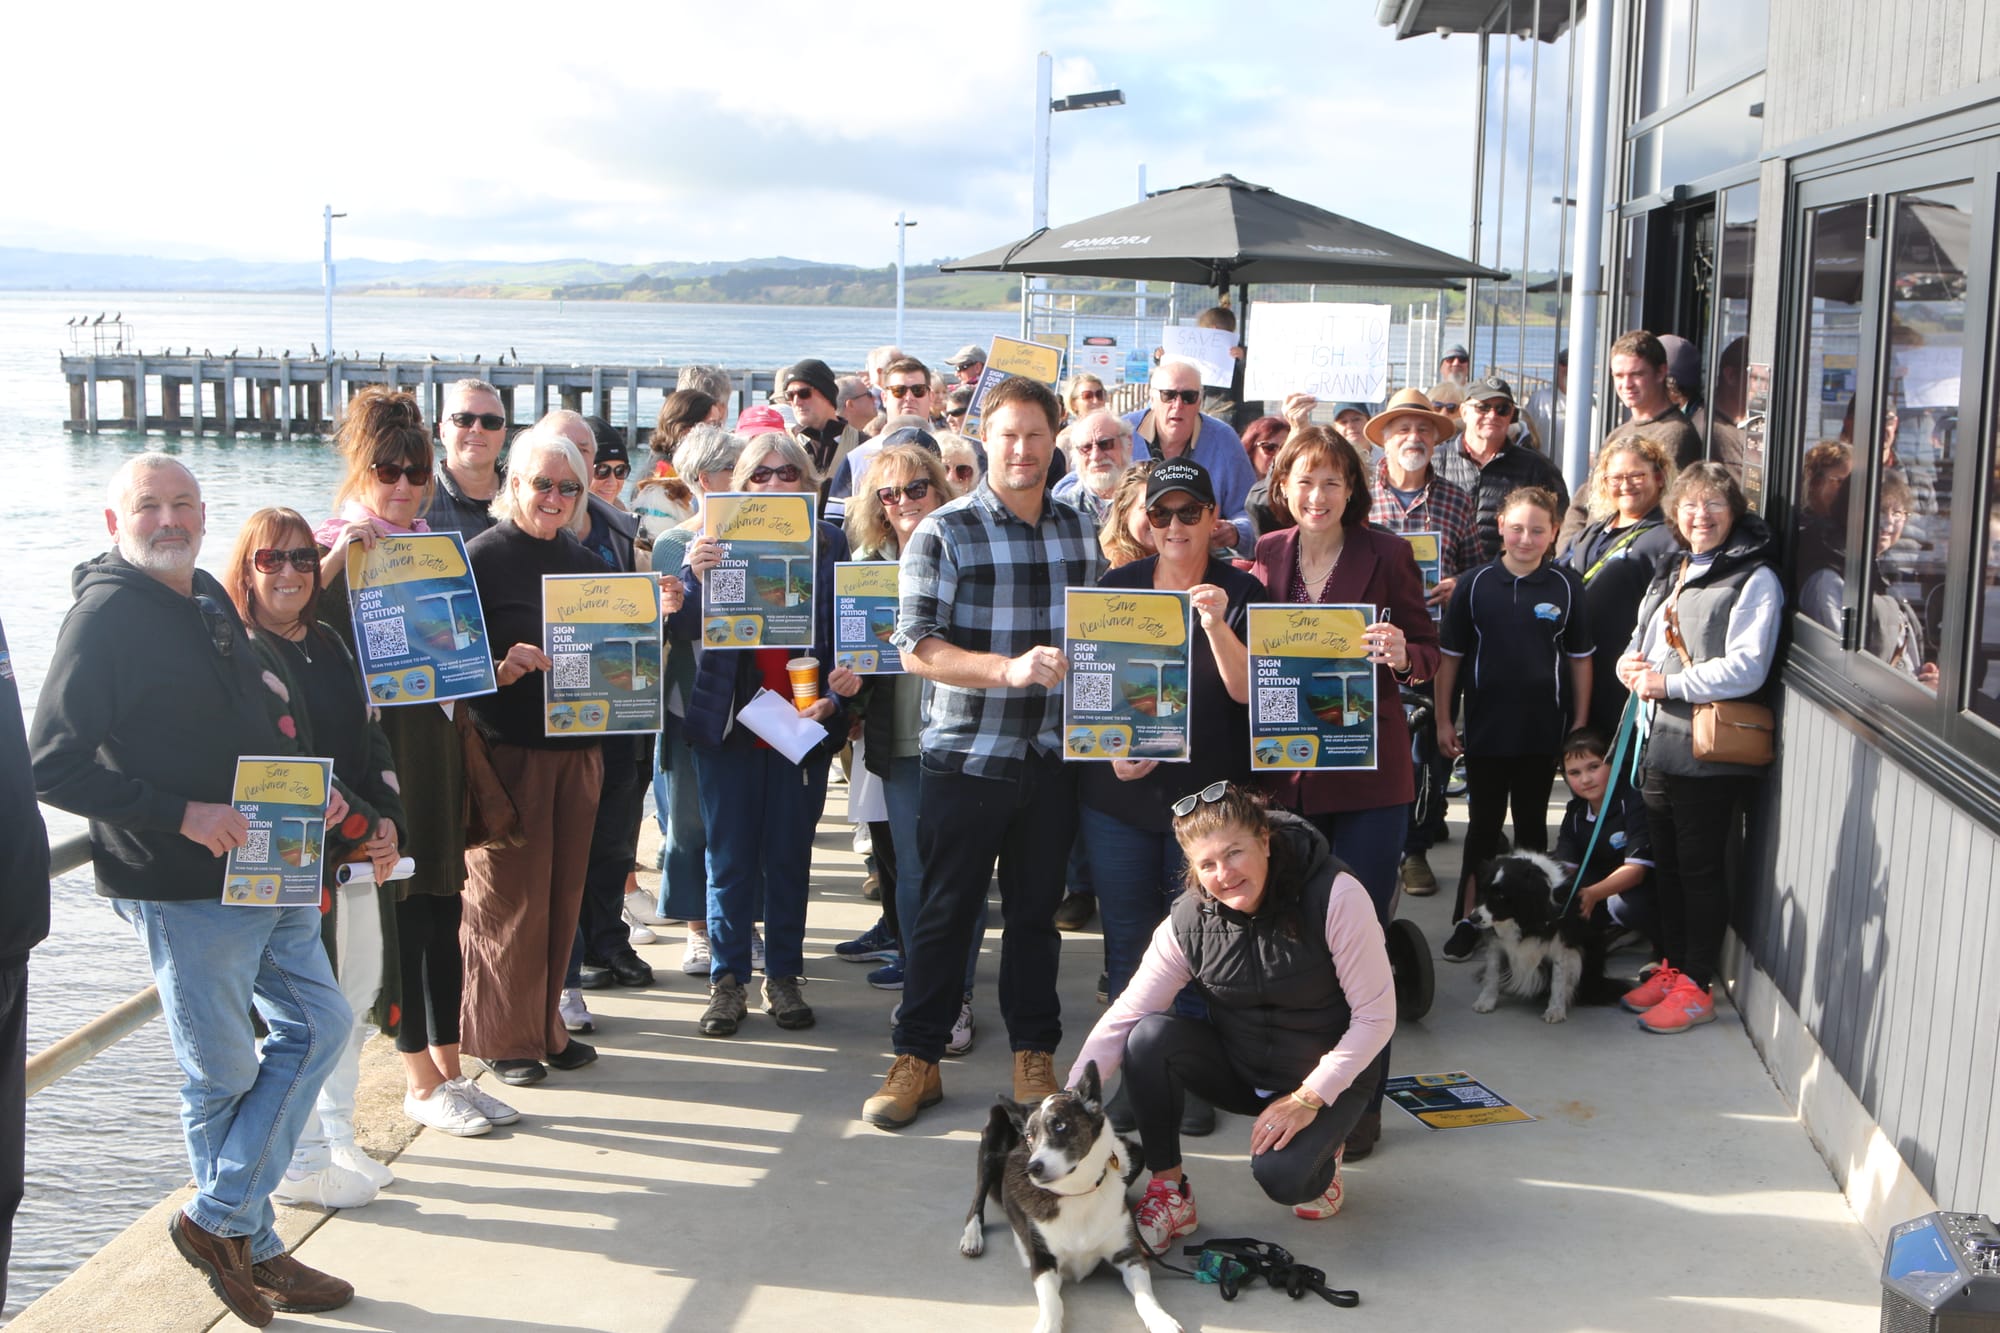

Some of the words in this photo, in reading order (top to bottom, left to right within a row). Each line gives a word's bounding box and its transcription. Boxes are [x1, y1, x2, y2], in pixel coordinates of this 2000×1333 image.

[1060, 235, 1152, 249] BOMBORA
[1354, 315, 1383, 344] TO
[1176, 329, 1223, 348] SAVE
[1303, 371, 1384, 395] GRANNY
[1154, 469, 1166, 477] Go
[1167, 465, 1199, 476] Fishing
[1160, 472, 1193, 481] Victoria
[738, 498, 767, 513] Save
[768, 516, 794, 536] Jetty
[379, 539, 413, 554] Save
[419, 553, 449, 572] Jetty
[580, 579, 611, 596] Save
[359, 590, 383, 602] SIGN
[361, 600, 382, 611] OUR
[612, 598, 640, 617] Jetty
[1104, 595, 1137, 612] Save
[362, 605, 406, 621] PETITION
[1286, 610, 1320, 628] Save
[553, 626, 575, 634] SIGN
[1137, 616, 1167, 639] Jetty
[553, 635, 573, 643] OUR
[1320, 631, 1351, 652] Jetty
[553, 643, 593, 651] PETITION
[1074, 643, 1097, 652] SIGN
[1074, 652, 1095, 661] OUR
[1257, 659, 1281, 668] SIGN
[1074, 662, 1116, 672] PETITION
[1258, 668, 1279, 677] OUR
[1258, 677, 1300, 686] PETITION
[264, 763, 289, 777] Save
[289, 780, 312, 800] Jetty
[240, 804, 259, 812] SIGN
[249, 820, 273, 828] TITION
